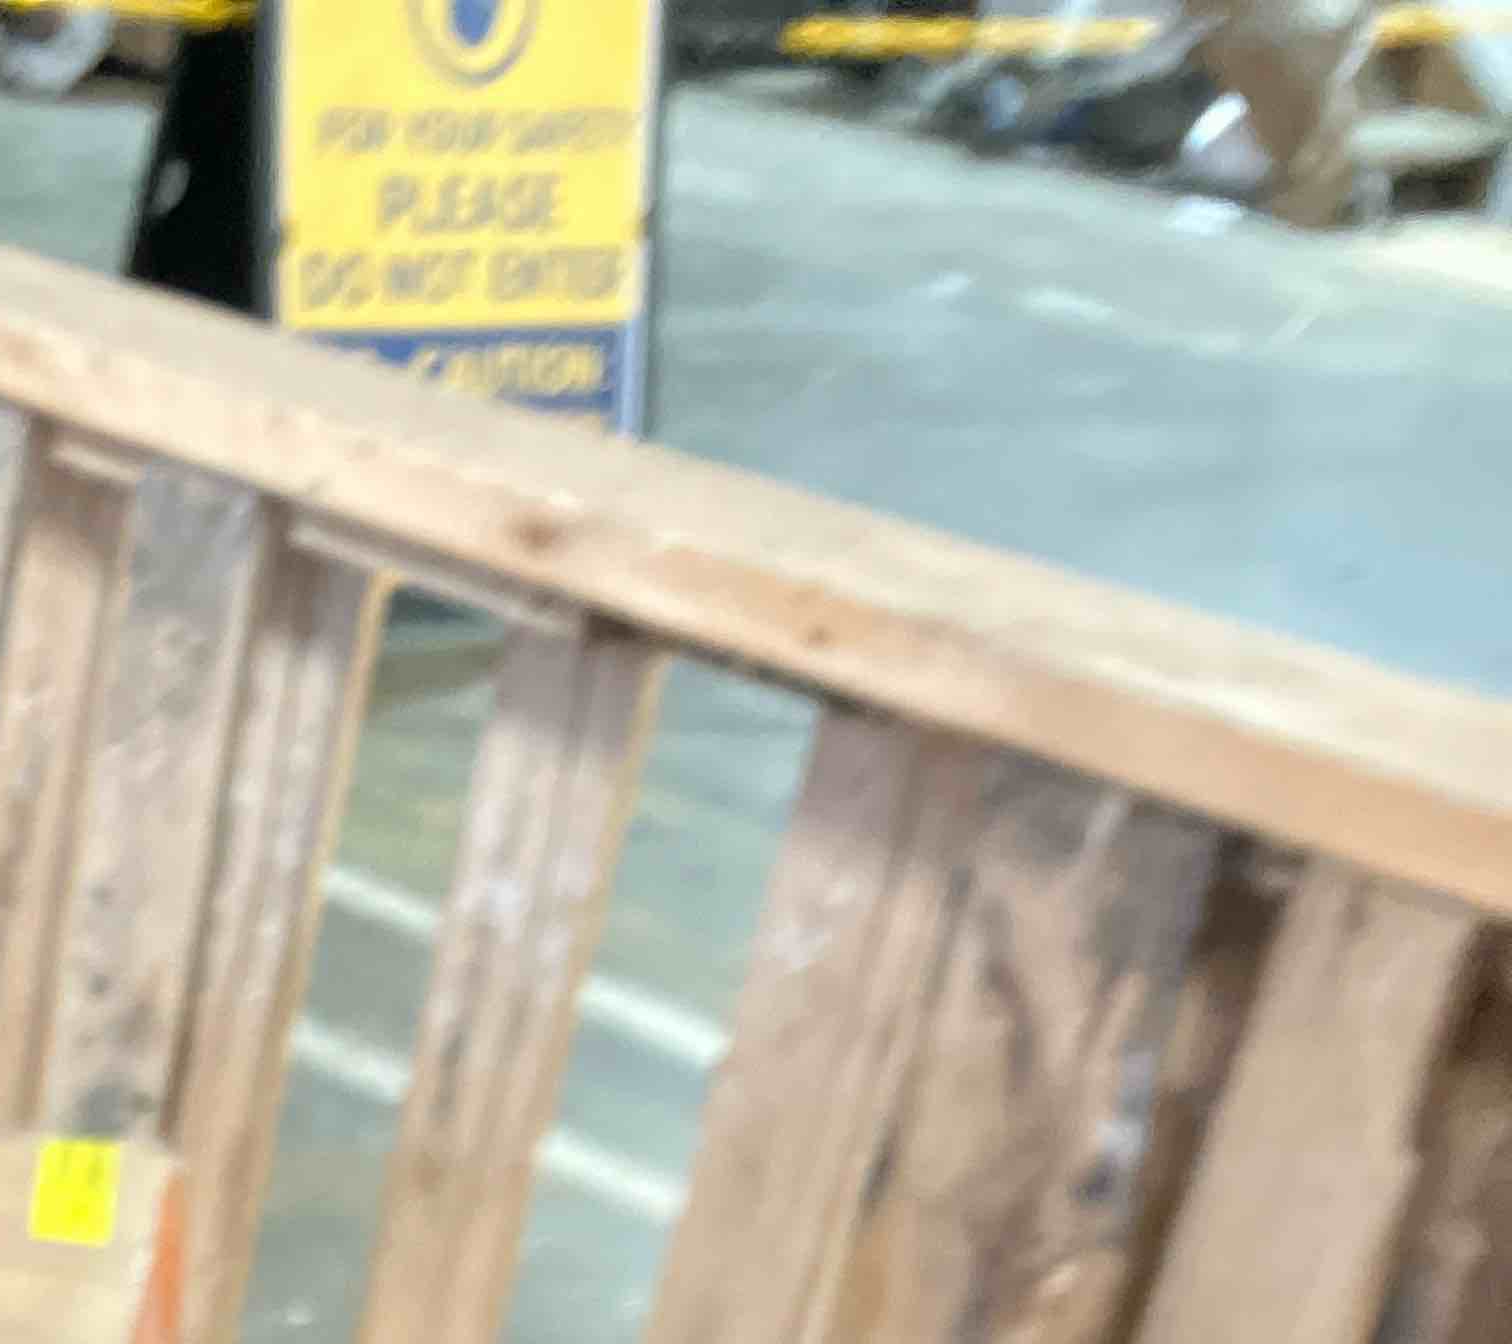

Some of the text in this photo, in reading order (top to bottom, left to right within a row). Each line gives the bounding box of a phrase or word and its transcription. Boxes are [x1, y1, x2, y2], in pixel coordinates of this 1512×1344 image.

[375, 169, 566, 235] PLEASE
[300, 244, 624, 311] DO NOT ENTER
